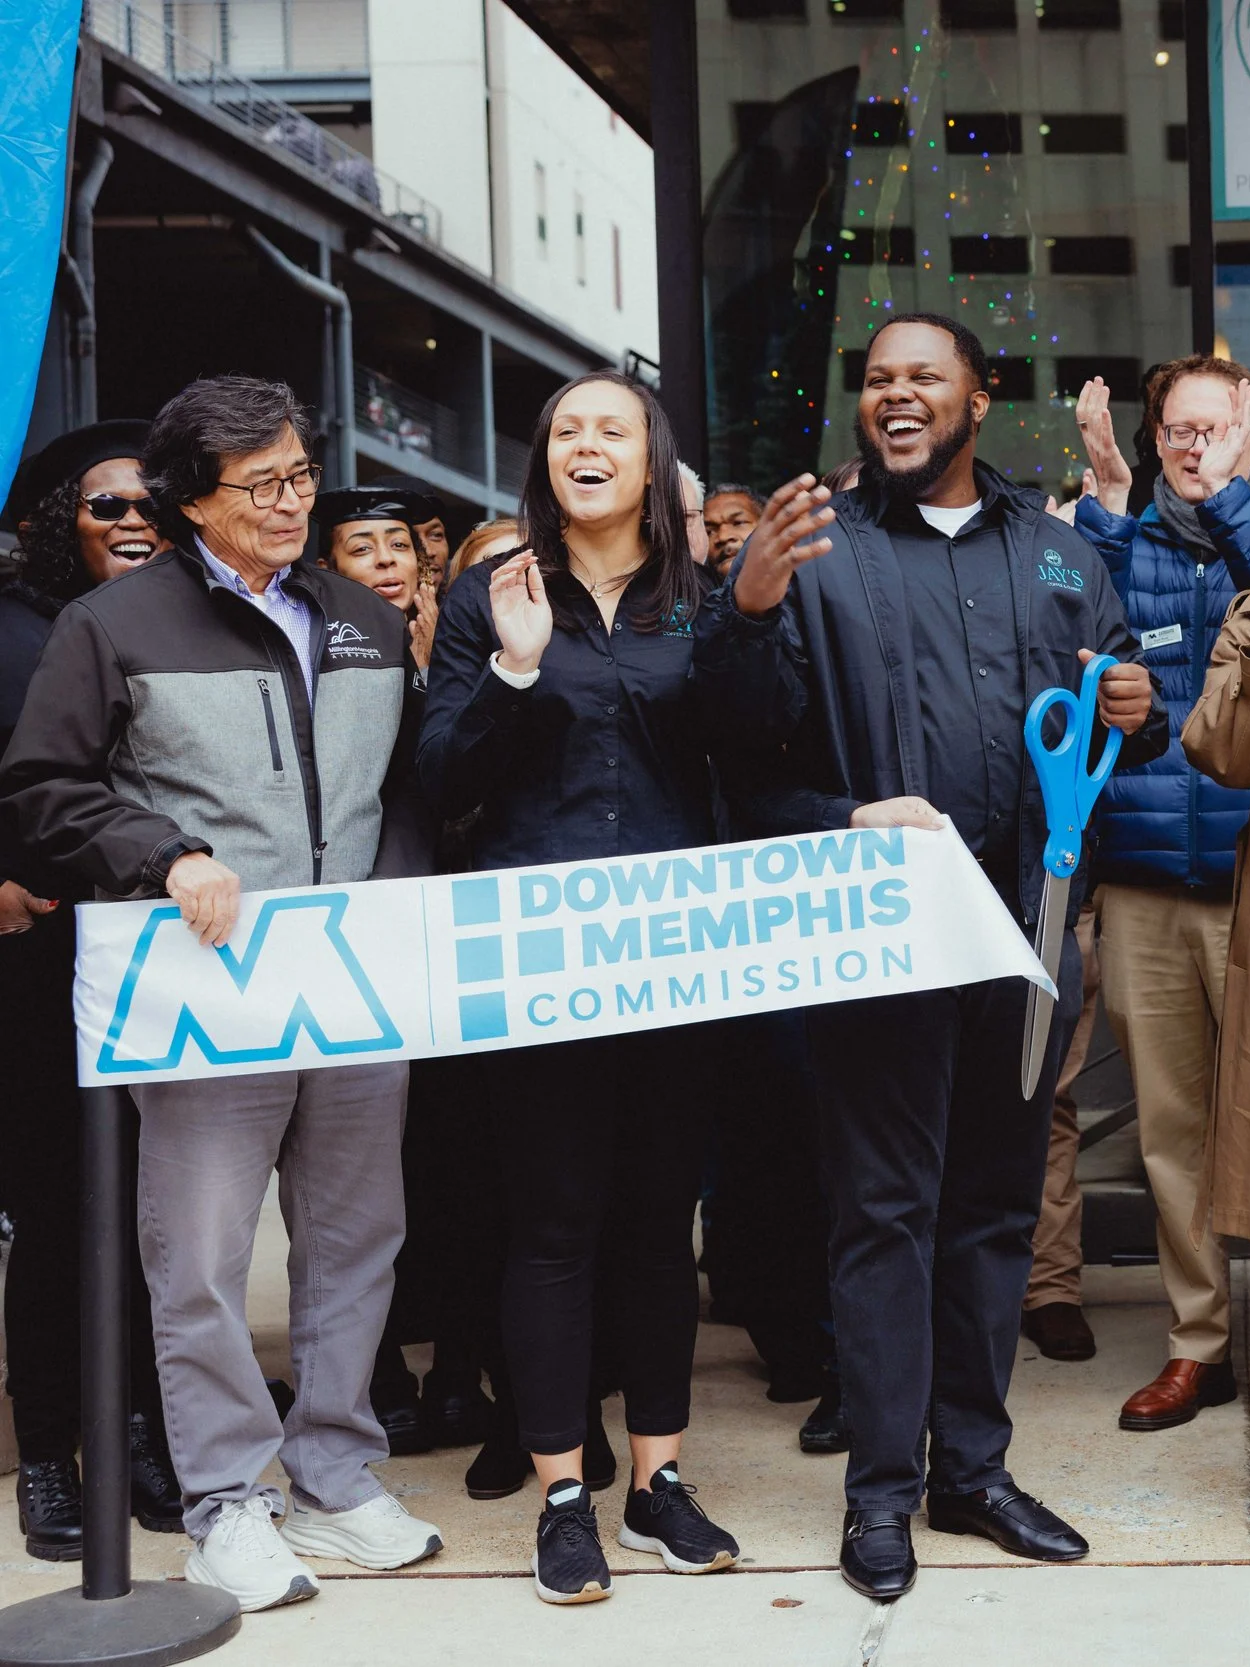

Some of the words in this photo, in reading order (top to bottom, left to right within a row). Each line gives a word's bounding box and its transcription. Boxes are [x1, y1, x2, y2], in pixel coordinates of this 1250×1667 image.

[1038, 564, 1084, 587] JAY'S
[518, 826, 906, 919] DOWNTOWN
[581, 878, 912, 968] MEMPHIS
[526, 943, 913, 1027] COMMISSION
